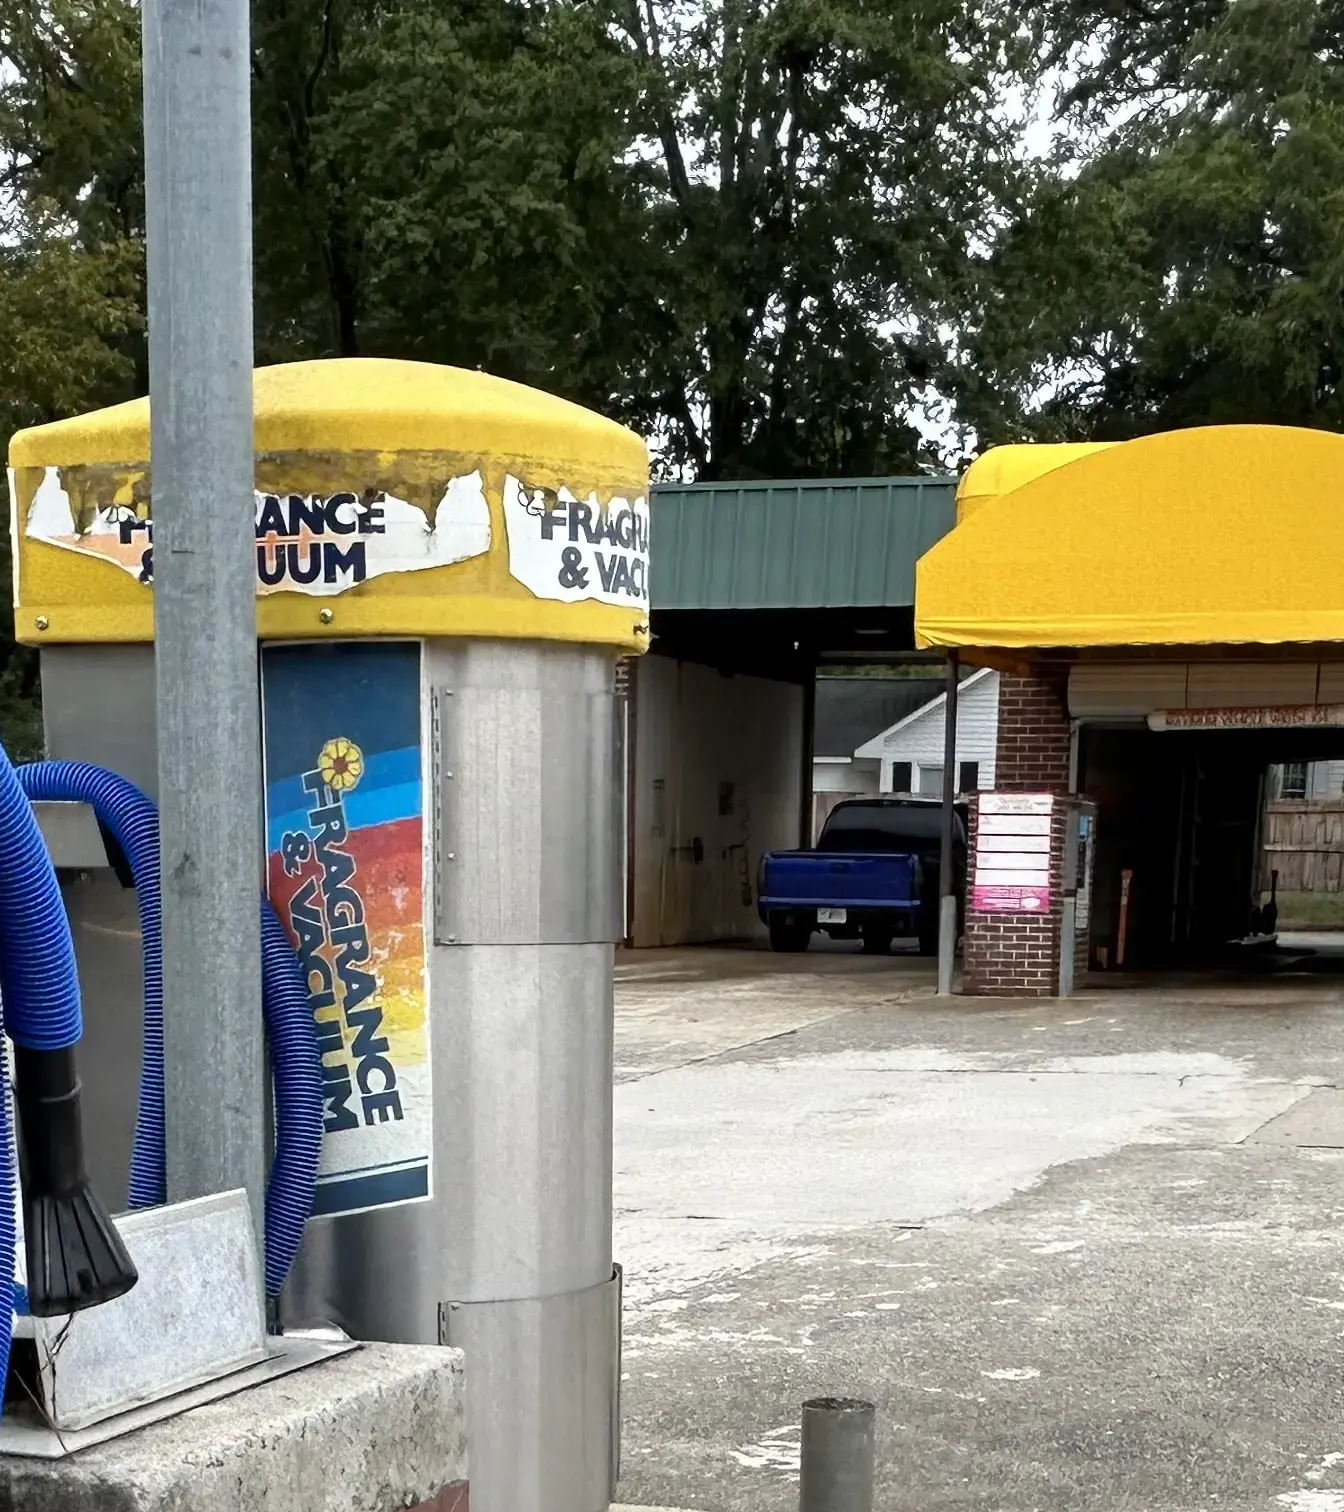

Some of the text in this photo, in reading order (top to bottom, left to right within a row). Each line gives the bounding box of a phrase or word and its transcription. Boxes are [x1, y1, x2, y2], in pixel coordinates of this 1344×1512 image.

[558, 546, 590, 590] &
[281, 831, 360, 1134] & VACUUM
[301, 768, 405, 1127] FRAGRANCE
